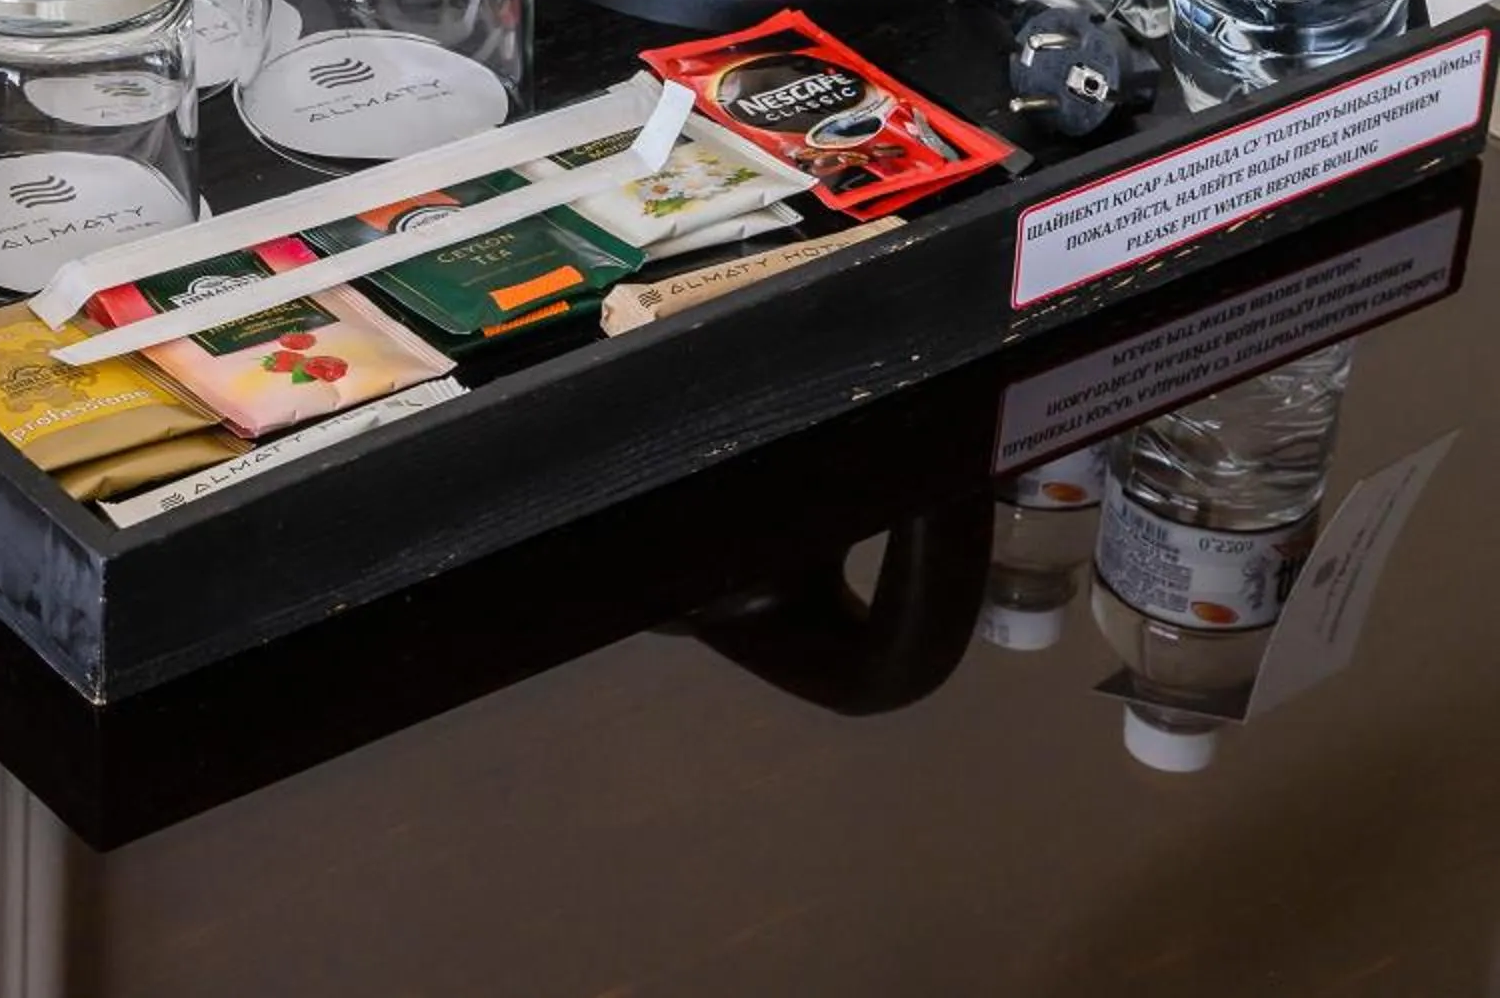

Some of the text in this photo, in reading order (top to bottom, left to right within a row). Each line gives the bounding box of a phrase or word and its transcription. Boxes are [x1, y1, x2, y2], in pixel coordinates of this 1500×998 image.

[310, 79, 441, 123] ALMATY
[764, 87, 858, 122] CLASSIC
[1066, 90, 1442, 251] ПОЖАЛУЙСТА, НАЛЕЙТЕ ВОДЫ ПЕРЕД КИПЯЧЕНИЕМ
[1163, 148, 1239, 186] АЛДЫНДА
[1243, 137, 1263, 156] СУ
[1126, 140, 1380, 251] PLEASE PUT WATER BEFORE BOILING
[1, 205, 144, 251] ALMATY
[435, 232, 517, 264] CEYLON
[472, 250, 513, 266] TEA
[669, 257, 769, 295] ALMATY
